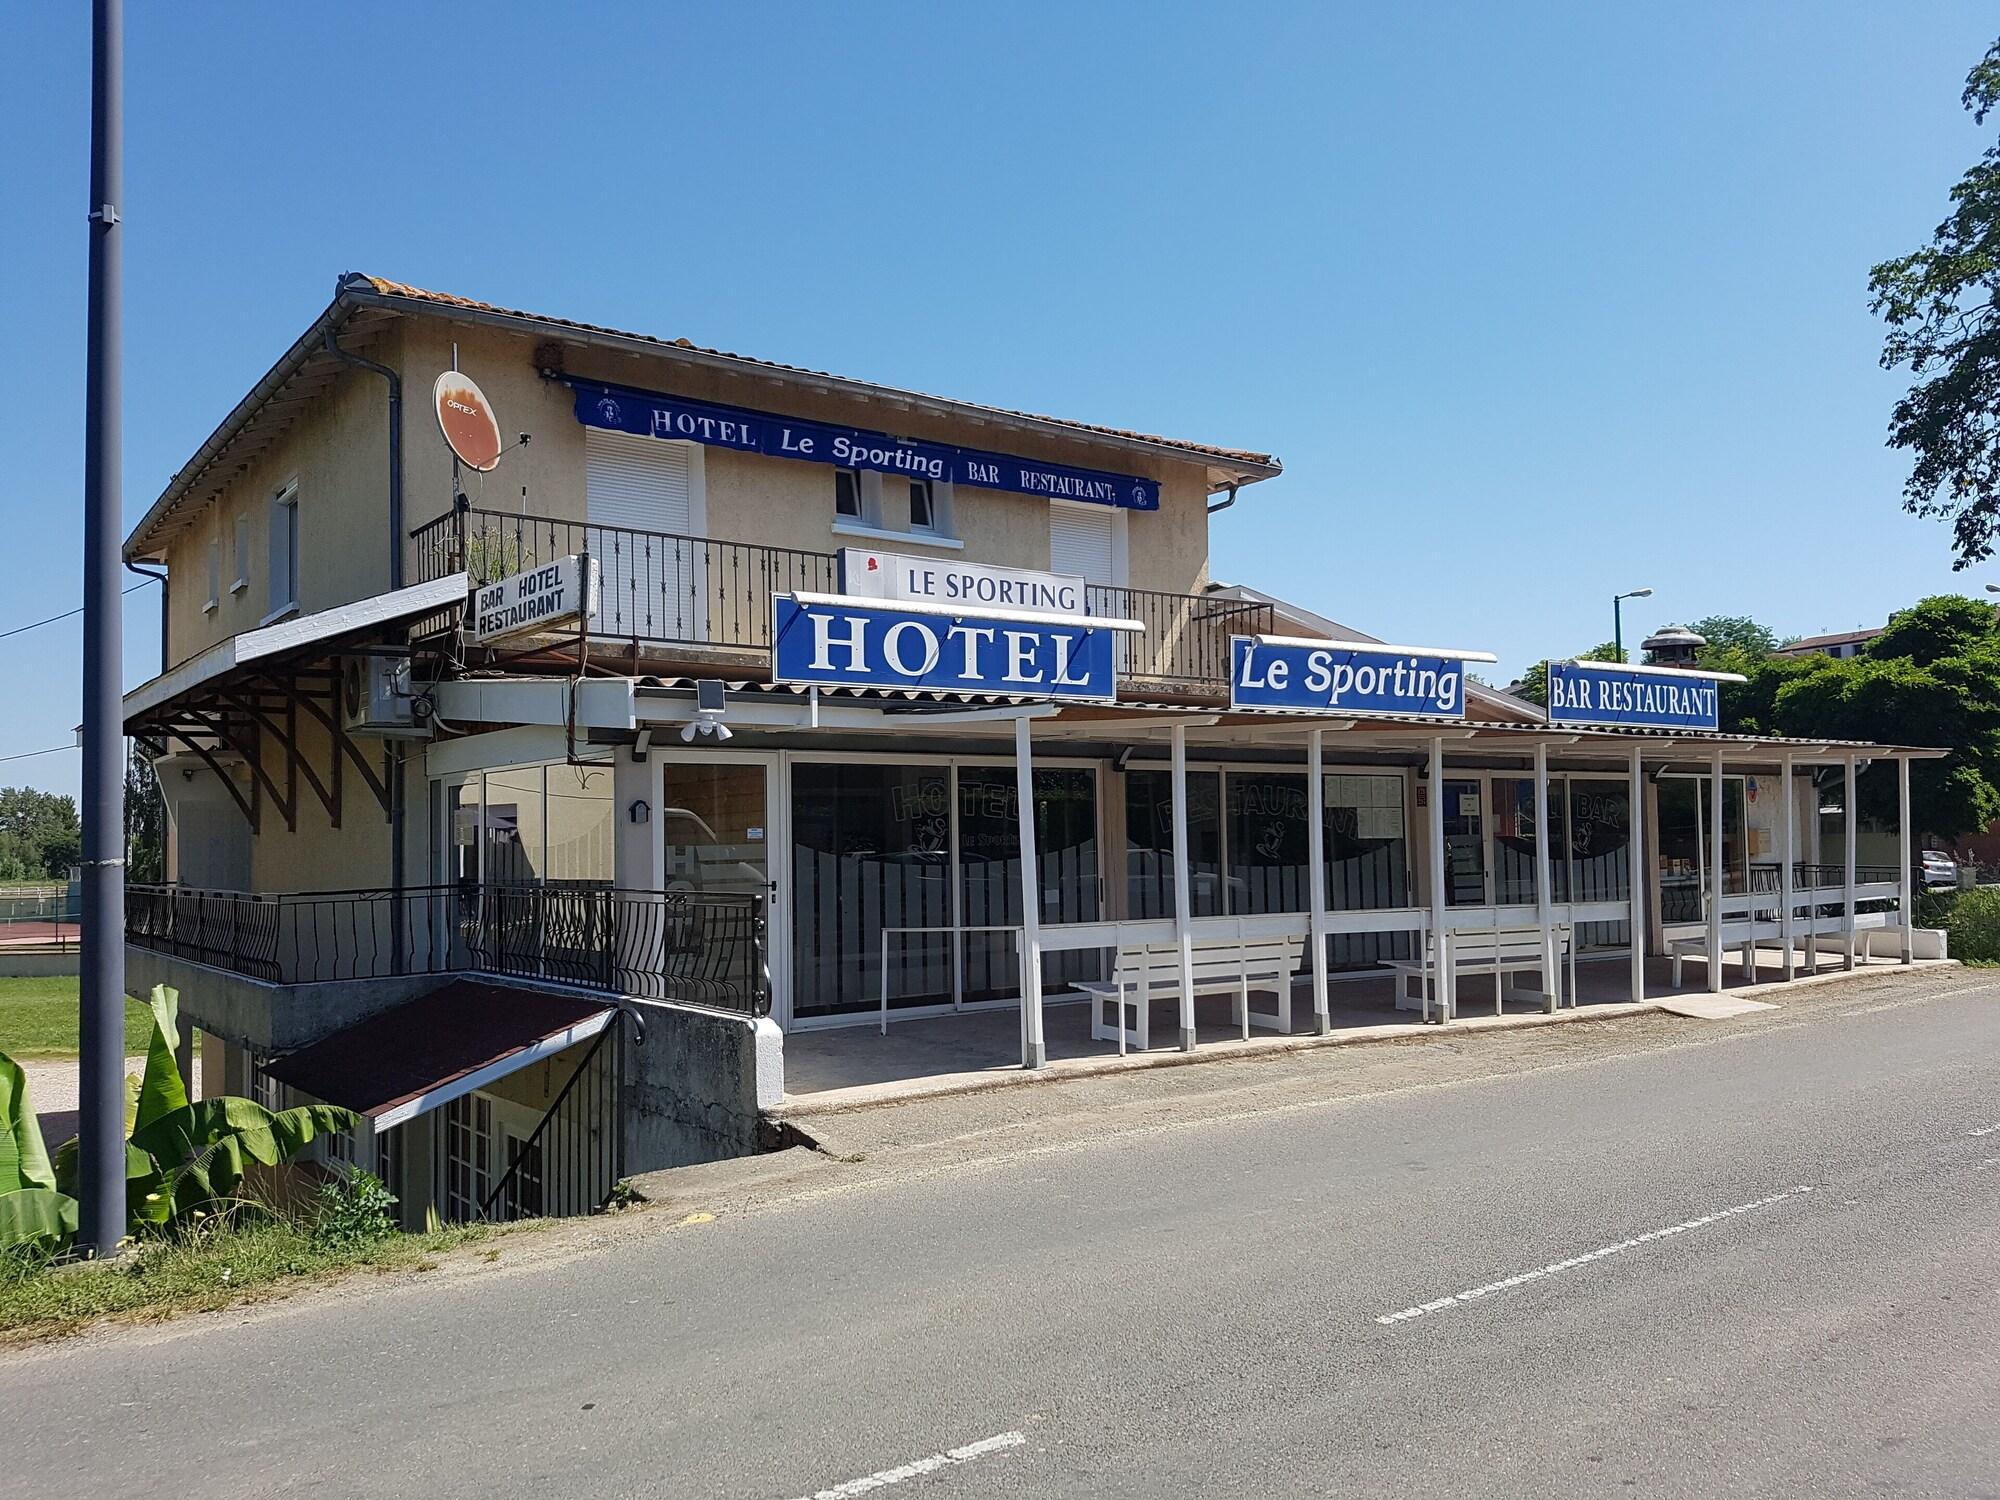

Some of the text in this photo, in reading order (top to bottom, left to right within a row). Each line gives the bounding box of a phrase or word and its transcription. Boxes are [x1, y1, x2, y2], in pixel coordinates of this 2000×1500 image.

[447, 400, 477, 417] OPTEX
[652, 409, 756, 446] HOTEL
[781, 429, 814, 453] Le
[832, 437, 943, 479] Sporting
[968, 462, 1000, 483] BAR
[1020, 470, 1114, 502] RESTAURANT
[480, 565, 564, 613] BAR HOTEL
[909, 569, 1075, 611] LE SPORTING
[478, 588, 565, 636] RESTAURANT
[807, 613, 1090, 687] HOTEL
[1240, 646, 1458, 711] Le Sporting
[1552, 677, 1715, 717] BAR RESTAURANT
[891, 781, 1019, 822] HOTEL
[1576, 791, 1620, 829] BAR
